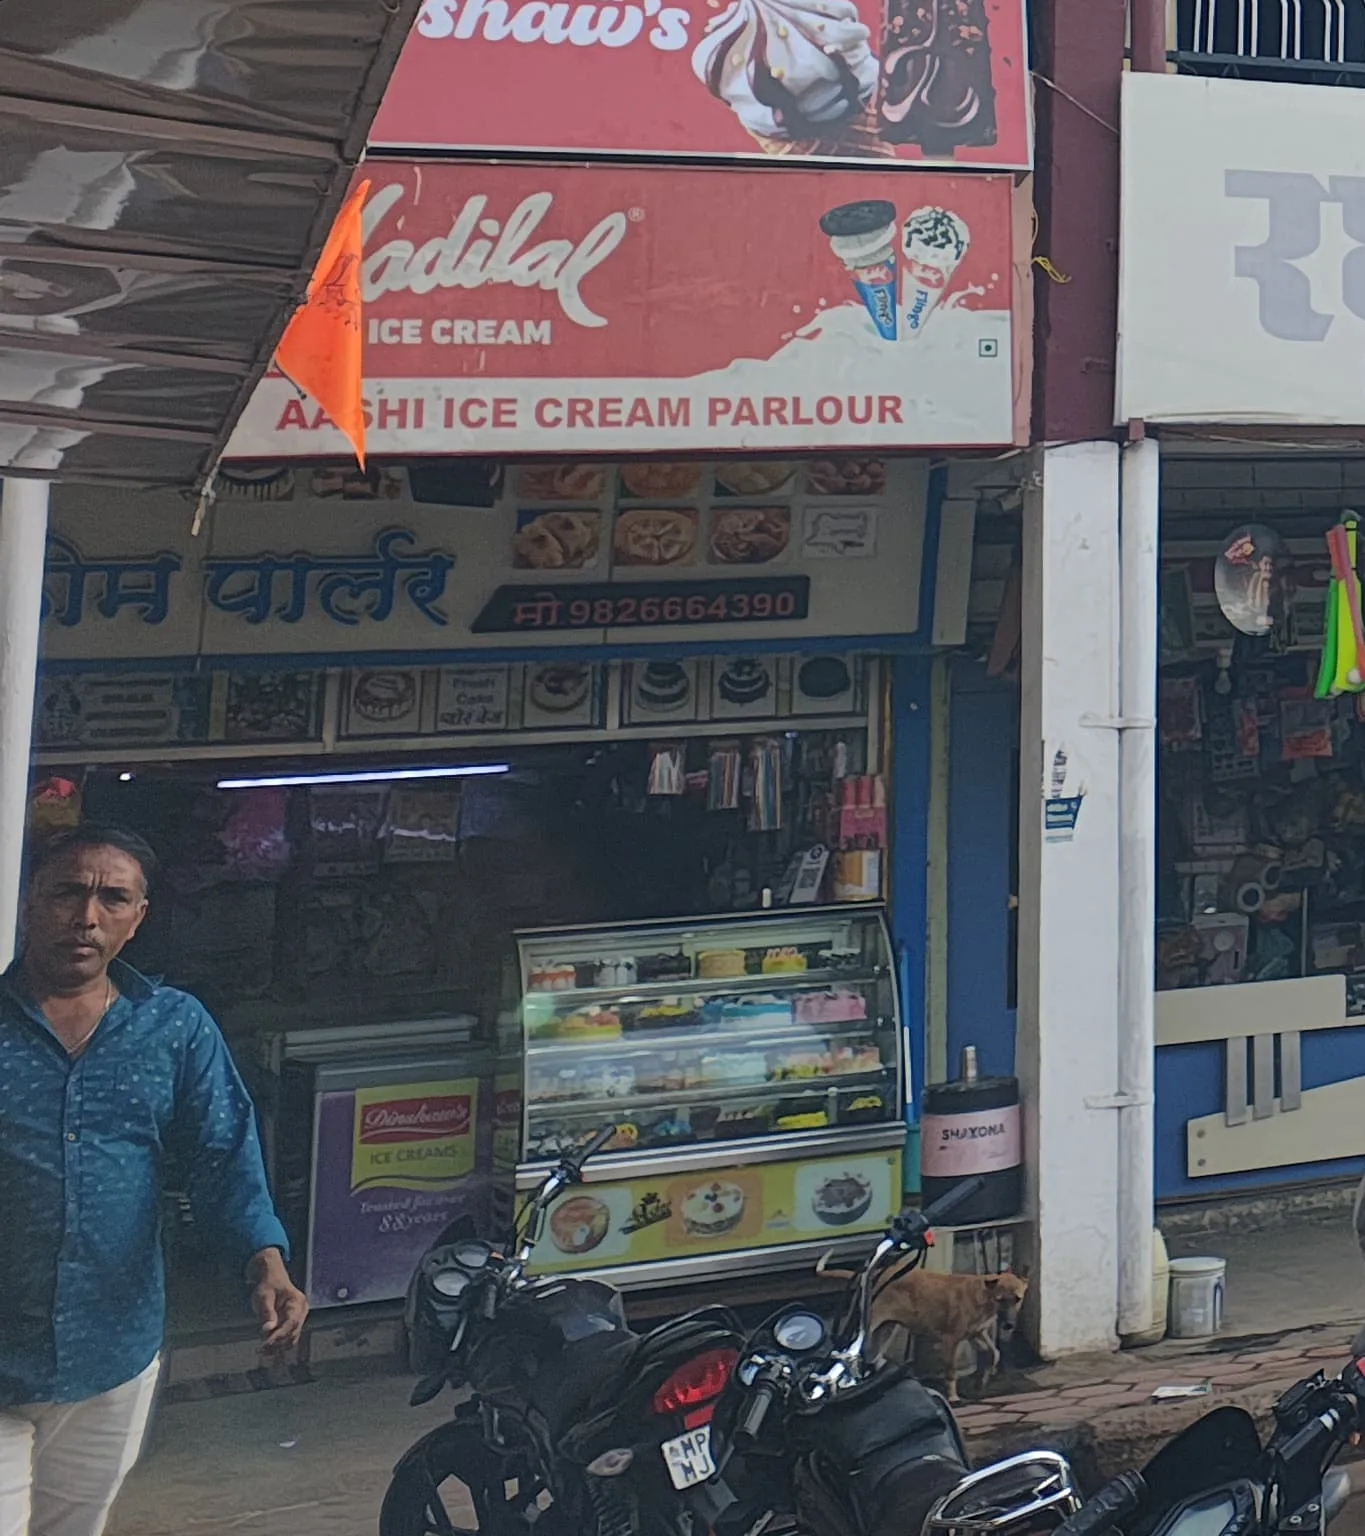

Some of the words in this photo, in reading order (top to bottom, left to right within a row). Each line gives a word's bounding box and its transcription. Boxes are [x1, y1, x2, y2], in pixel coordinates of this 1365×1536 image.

[368, 317, 424, 346] ICE
[431, 318, 552, 346] CREAM
[443, 394, 518, 430] ICE
[532, 394, 693, 430] CREAM
[707, 392, 904, 429] PARLOUR
[207, 526, 456, 627] पार्लर
[370, 1150, 392, 1165] ICE
